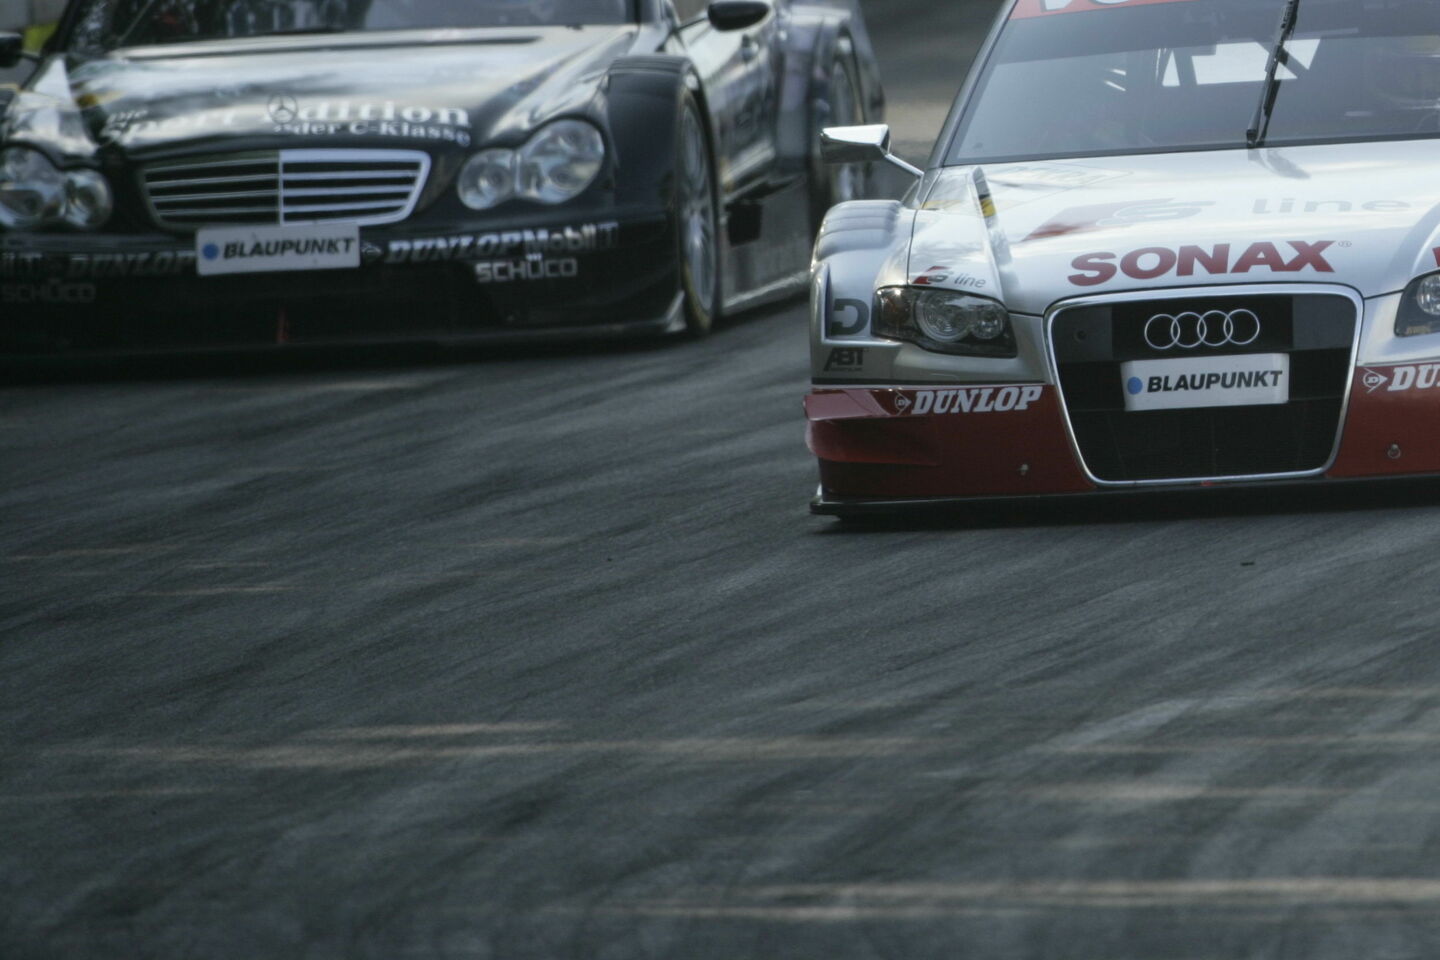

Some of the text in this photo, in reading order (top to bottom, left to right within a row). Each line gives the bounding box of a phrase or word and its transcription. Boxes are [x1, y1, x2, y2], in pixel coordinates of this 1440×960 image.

[1252, 197, 1411, 215] line
[222, 236, 356, 260] BLAUPUNKT
[475, 253, 578, 283] SCHÜCO
[1067, 239, 1336, 287] SONAX
[954, 272, 987, 289] line
[823, 346, 865, 372] ABT
[1146, 369, 1283, 394] BLAUPUNKT
[911, 385, 1044, 415] DUNLOP
